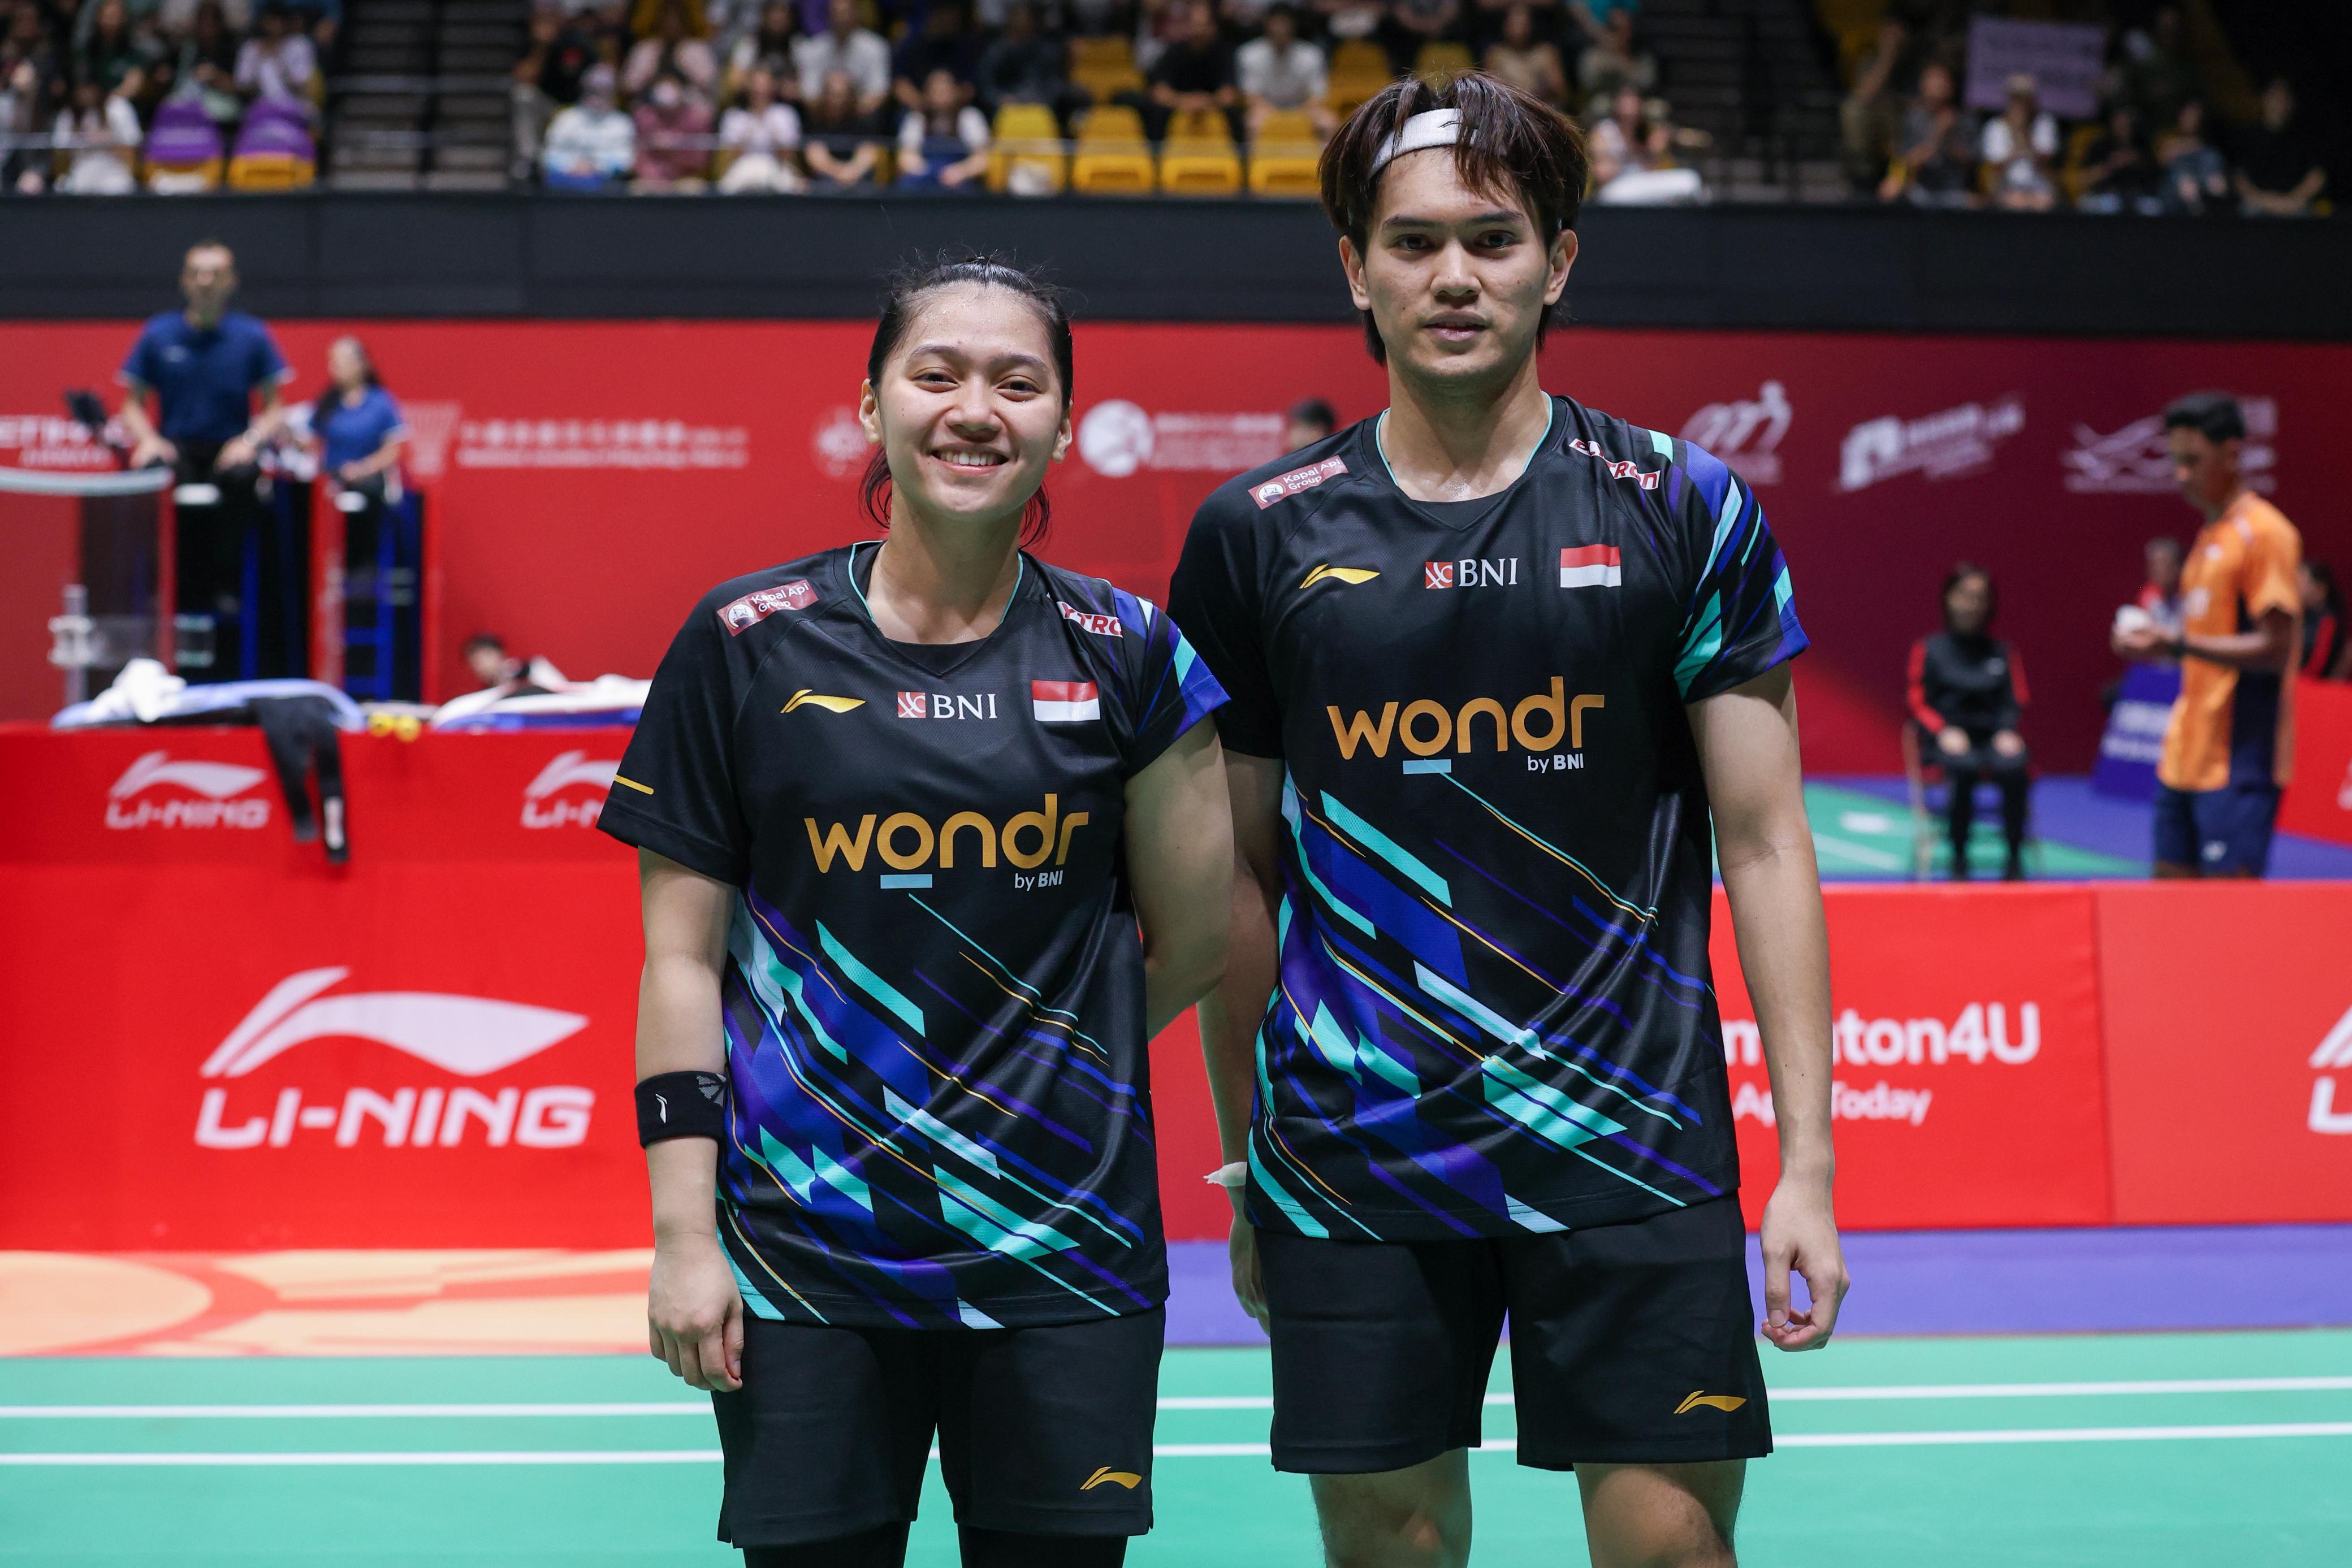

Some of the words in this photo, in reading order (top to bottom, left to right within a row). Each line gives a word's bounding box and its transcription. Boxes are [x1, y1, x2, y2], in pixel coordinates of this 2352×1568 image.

[1283, 467, 1319, 483] Kapal
[1321, 458, 1342, 472] Api
[1288, 475, 1322, 490] Group
[1459, 558, 1518, 587] BNI
[751, 590, 786, 605] Kapal
[789, 583, 809, 596] Api
[758, 600, 791, 613] Group
[1062, 603, 1122, 635] YTRO
[932, 694, 998, 720] BNI
[1326, 676, 1605, 760] wondr
[1527, 755, 1550, 774] by
[1553, 753, 1584, 770] BNI
[105, 800, 270, 829] LI-NING
[521, 800, 603, 829] LI-N
[804, 794, 1088, 874] wondr
[1014, 873, 1035, 891] by
[1037, 870, 1063, 887] BNI
[194, 1086, 595, 1149] LI-NING
